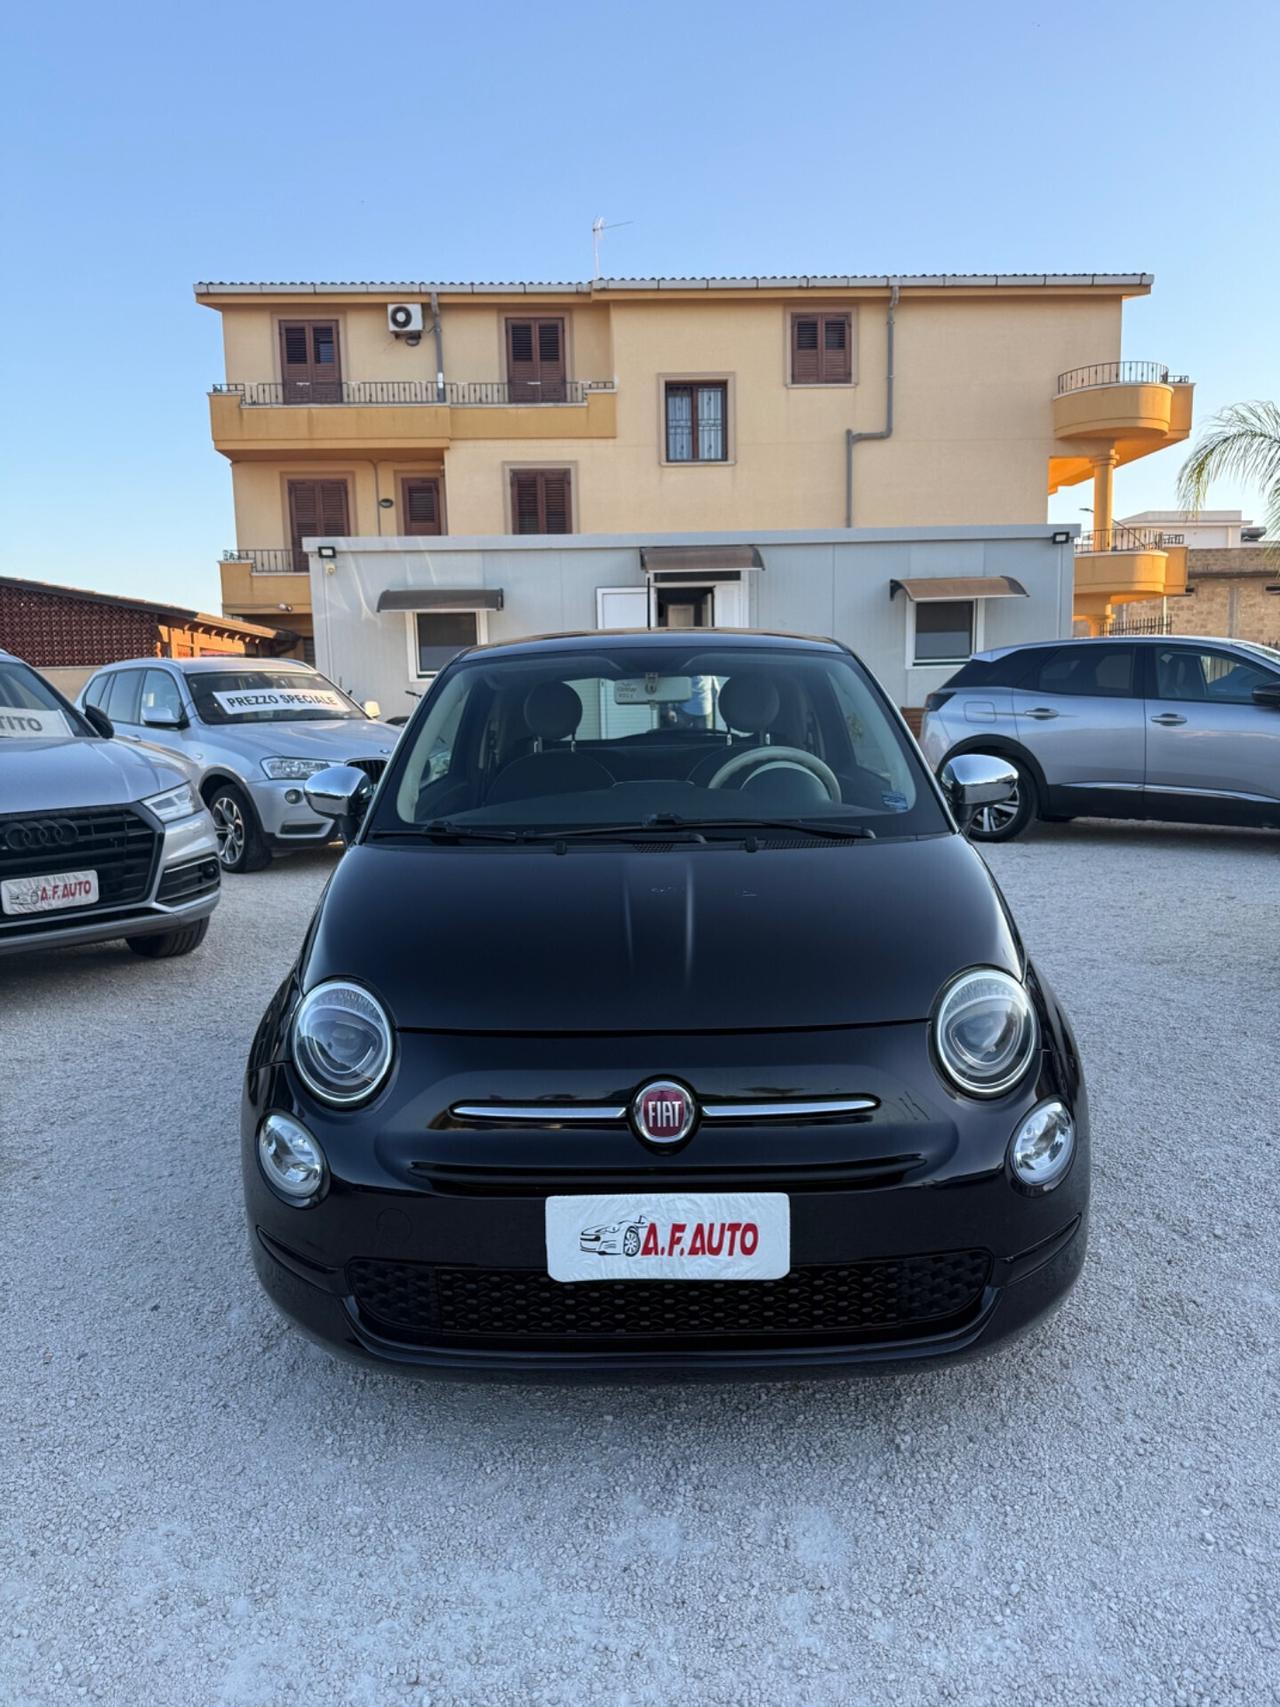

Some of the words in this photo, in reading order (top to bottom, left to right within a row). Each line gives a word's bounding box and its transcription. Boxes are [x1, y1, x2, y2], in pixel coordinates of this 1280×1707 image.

[227, 694, 279, 708] PREZZO
[280, 694, 338, 706] SPECIALE
[648, 1101, 682, 1127] FIAT
